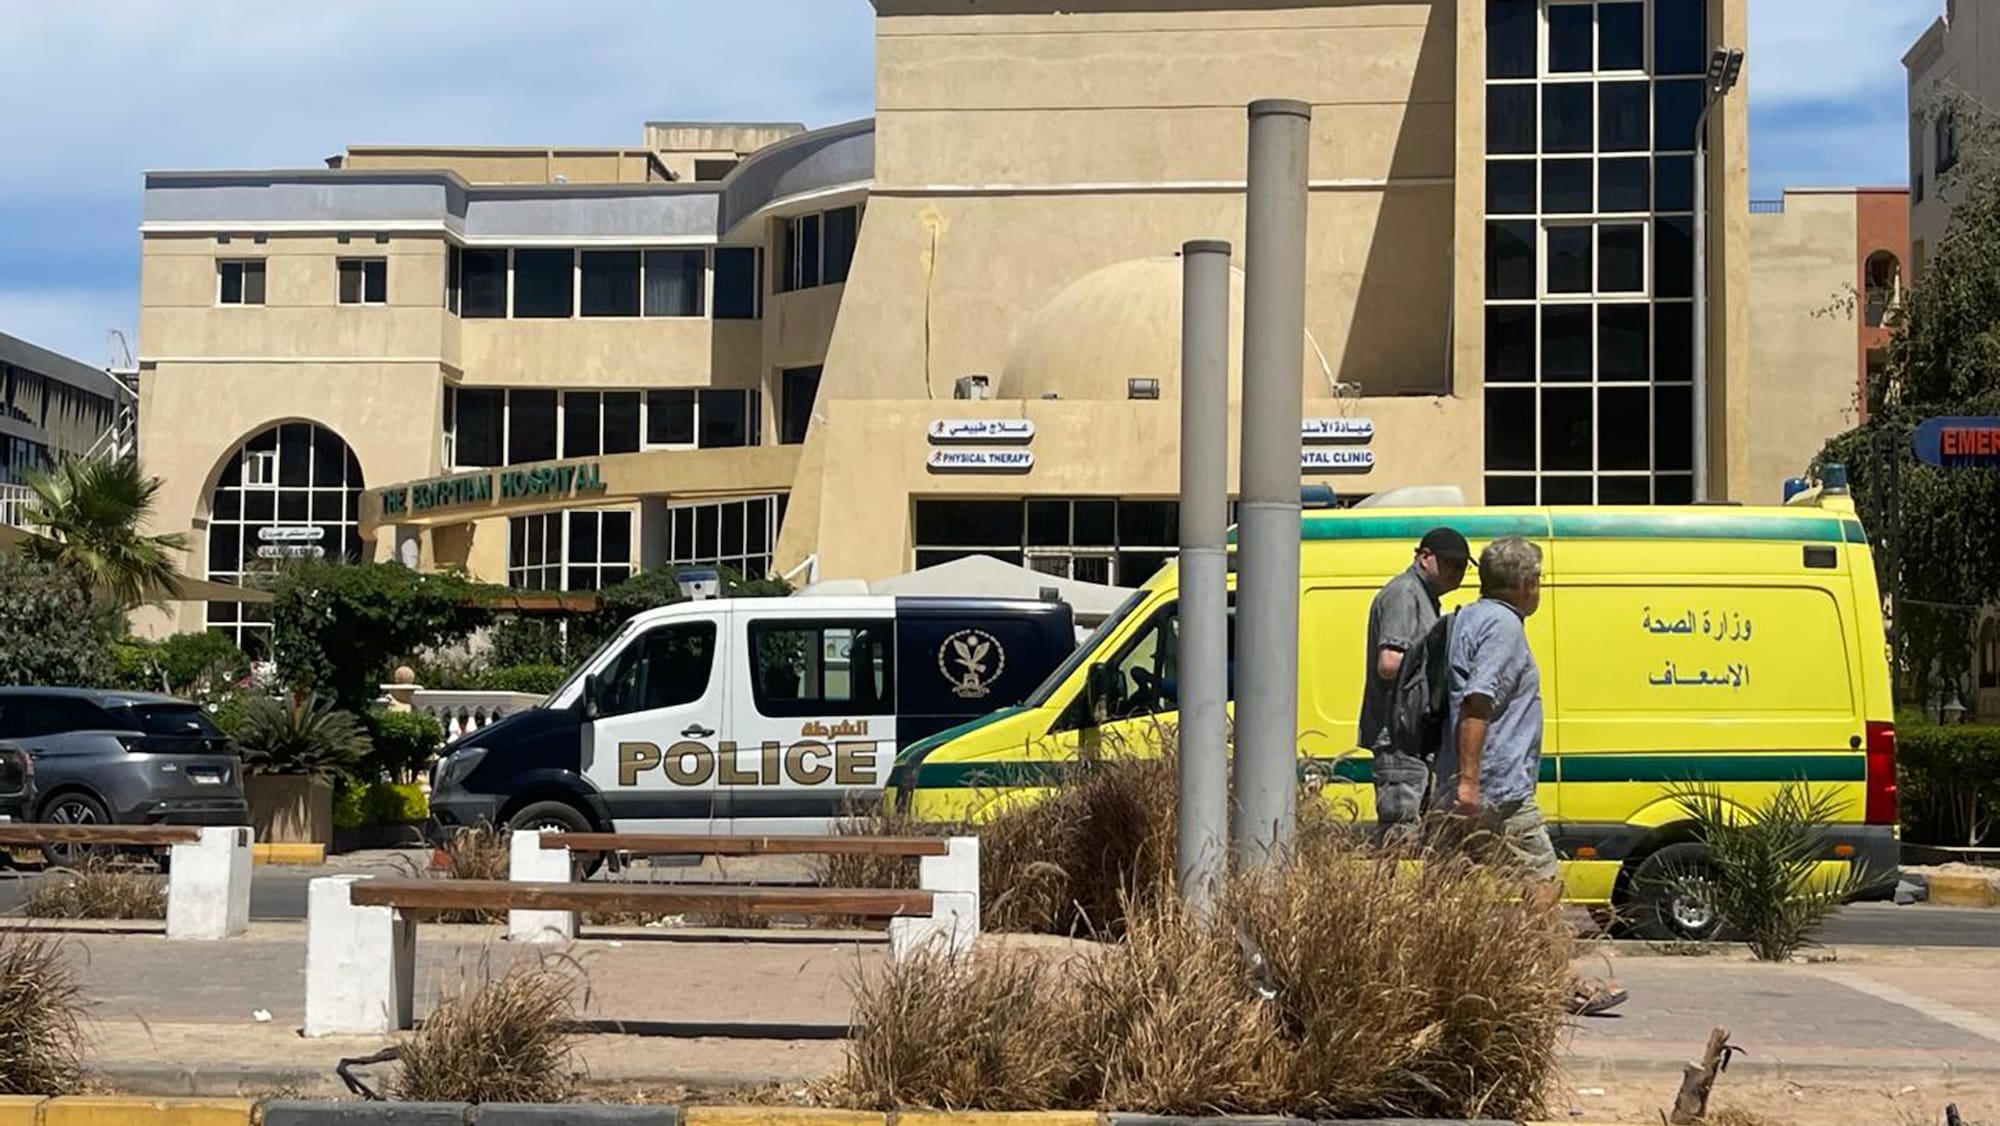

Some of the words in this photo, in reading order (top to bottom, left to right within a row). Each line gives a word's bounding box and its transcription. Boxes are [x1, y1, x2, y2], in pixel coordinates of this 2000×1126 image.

[949, 421, 987, 435] طبيعي
[988, 421, 1028, 434] علاج
[943, 452, 987, 464] PHYSICAL
[988, 452, 1031, 464] THERAPY
[1332, 452, 1373, 464] CLINIC
[380, 491, 408, 515] THE
[411, 473, 493, 509] EGYPTIAN
[500, 463, 608, 499] HOSPITAL
[1642, 606, 1697, 633] الصحة
[1703, 610, 1752, 641] وزارة
[801, 719, 868, 740] الشرطة
[618, 740, 878, 787] POLICE
